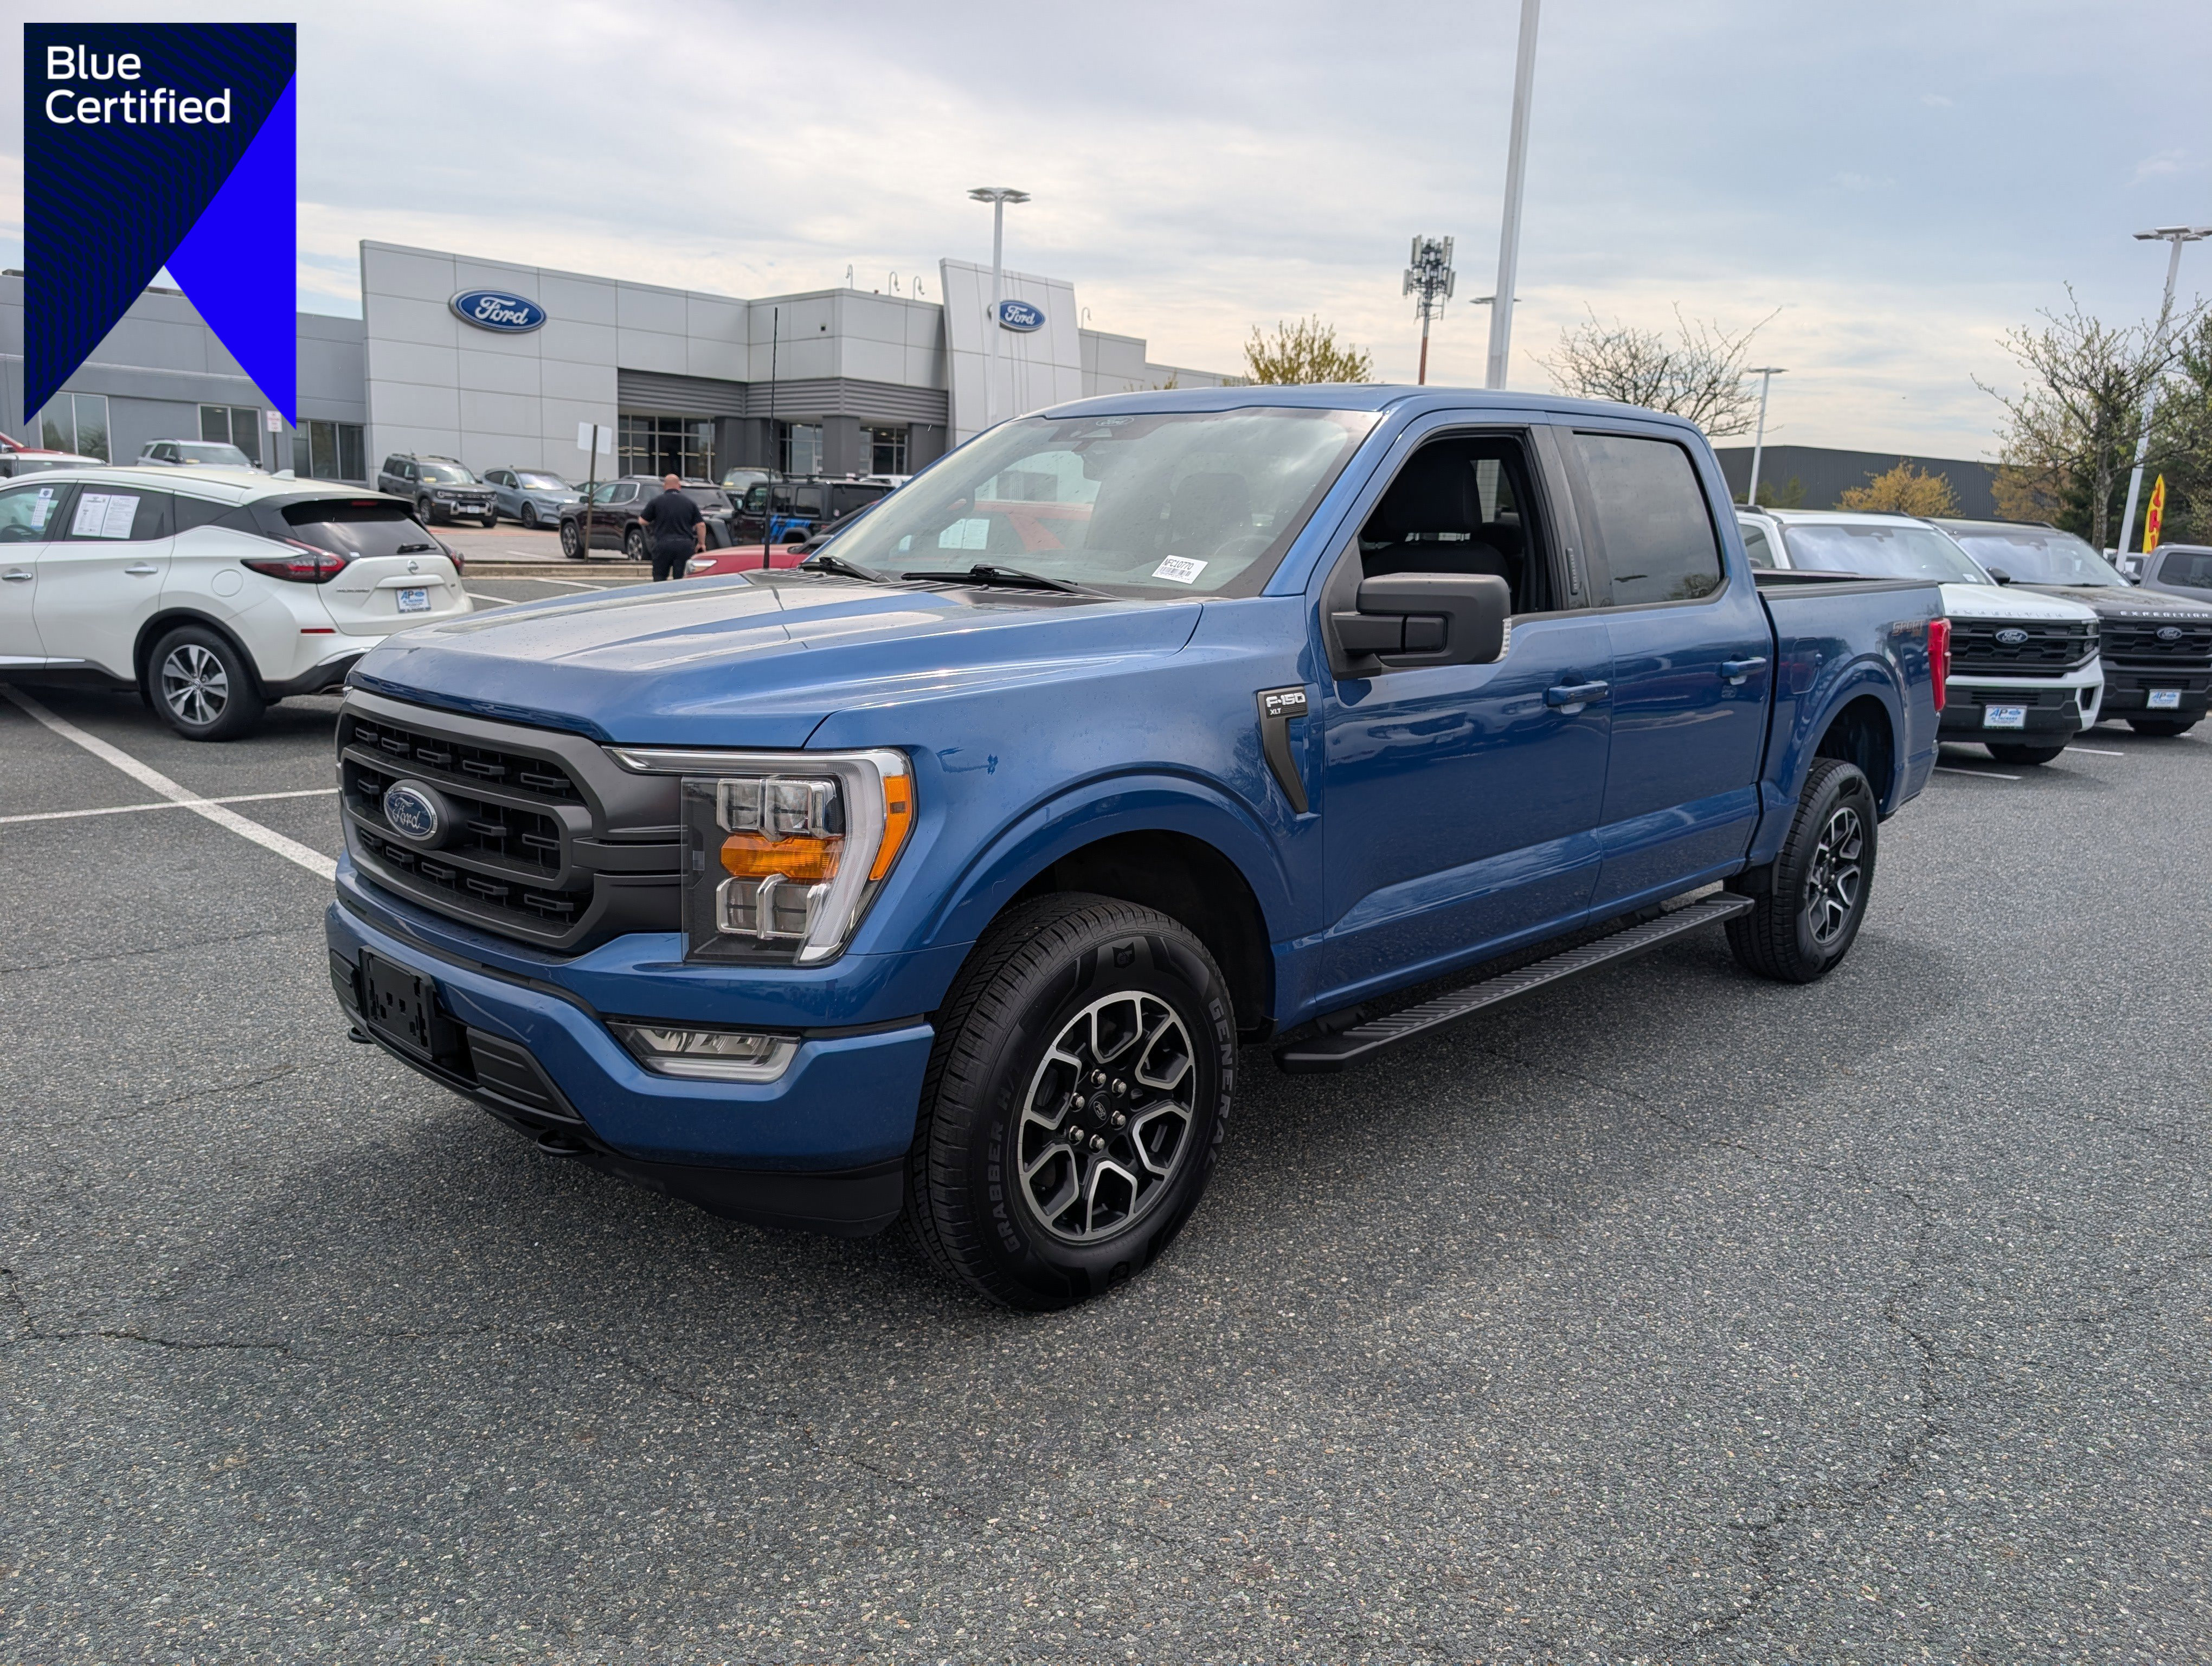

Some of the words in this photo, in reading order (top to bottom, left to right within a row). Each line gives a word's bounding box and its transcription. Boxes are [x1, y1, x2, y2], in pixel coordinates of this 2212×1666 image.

[474, 296, 529, 324] Ford
[1005, 305, 1036, 325] Ford
[401, 589, 414, 600] AP
[2002, 632, 2023, 642] Ford
[1266, 693, 1306, 707] F-150
[1989, 707, 2008, 717] AP
[393, 797, 421, 829] Ford
[1204, 997, 1233, 1169] GENERAL
[988, 1119, 1020, 1252] GRABBER
